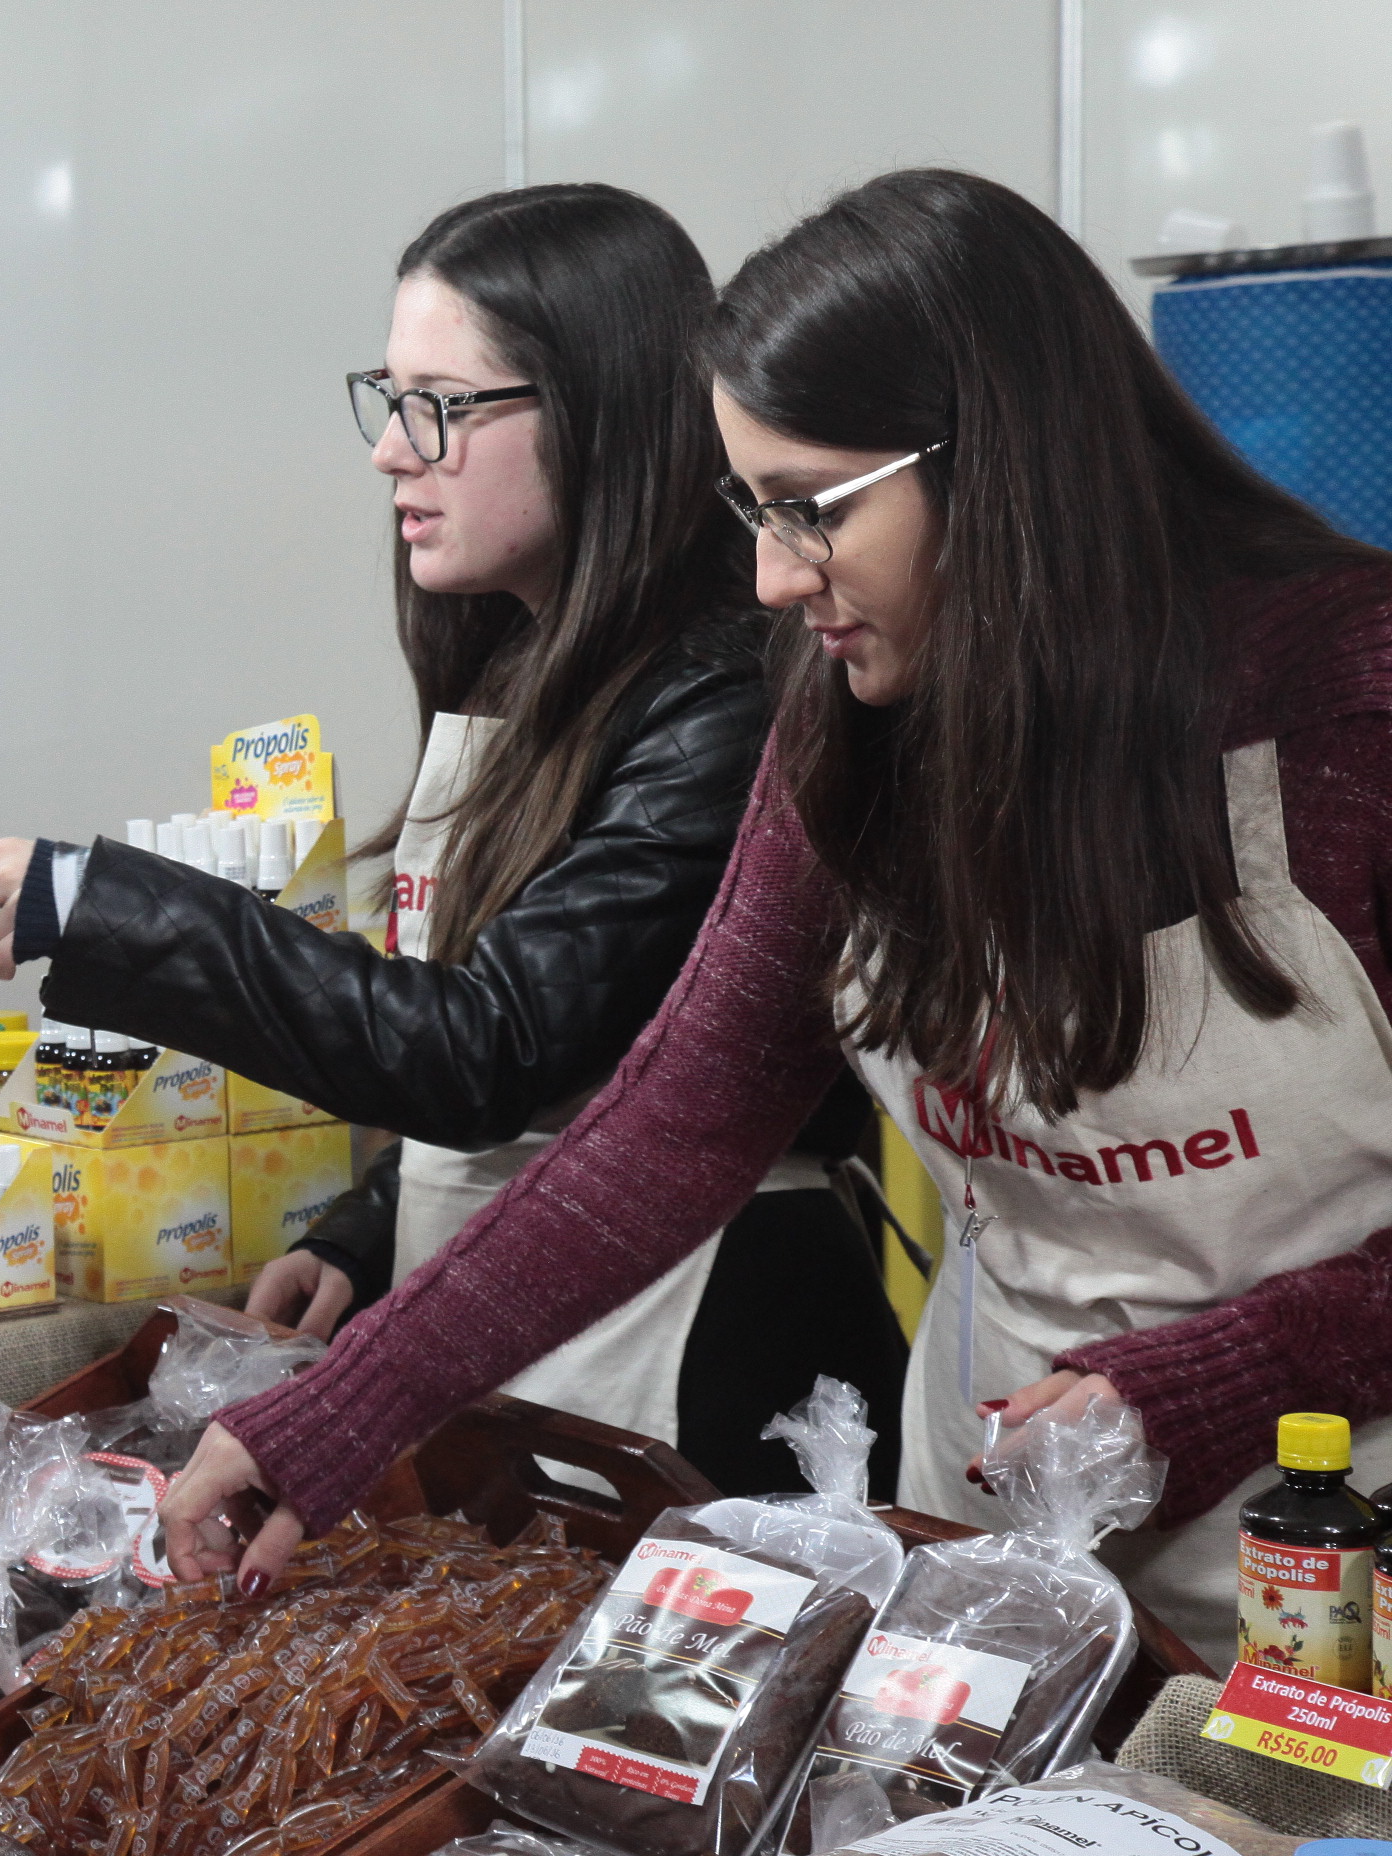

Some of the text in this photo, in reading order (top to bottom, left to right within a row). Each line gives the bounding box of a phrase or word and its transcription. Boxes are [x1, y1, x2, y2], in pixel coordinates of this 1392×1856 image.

[232, 722, 310, 765] Própolis
[16, 1107, 68, 1133] Minamel
[914, 1077, 1261, 1187] Minamel
[52, 1164, 81, 1193] olis
[156, 1212, 218, 1245] Própolis
[0, 1280, 51, 1298] Minamel
[1239, 1539, 1330, 1570] Extrato de
[1243, 1557, 1317, 1584] Própolis
[614, 1612, 745, 1658] Pão de Mel
[1251, 1674, 1392, 1724] Extrato de Própolis
[1286, 1706, 1338, 1731] 250ml
[844, 1721, 882, 1746] Pão
[882, 1727, 907, 1750] de
[1256, 1730, 1339, 1768] R$56,00
